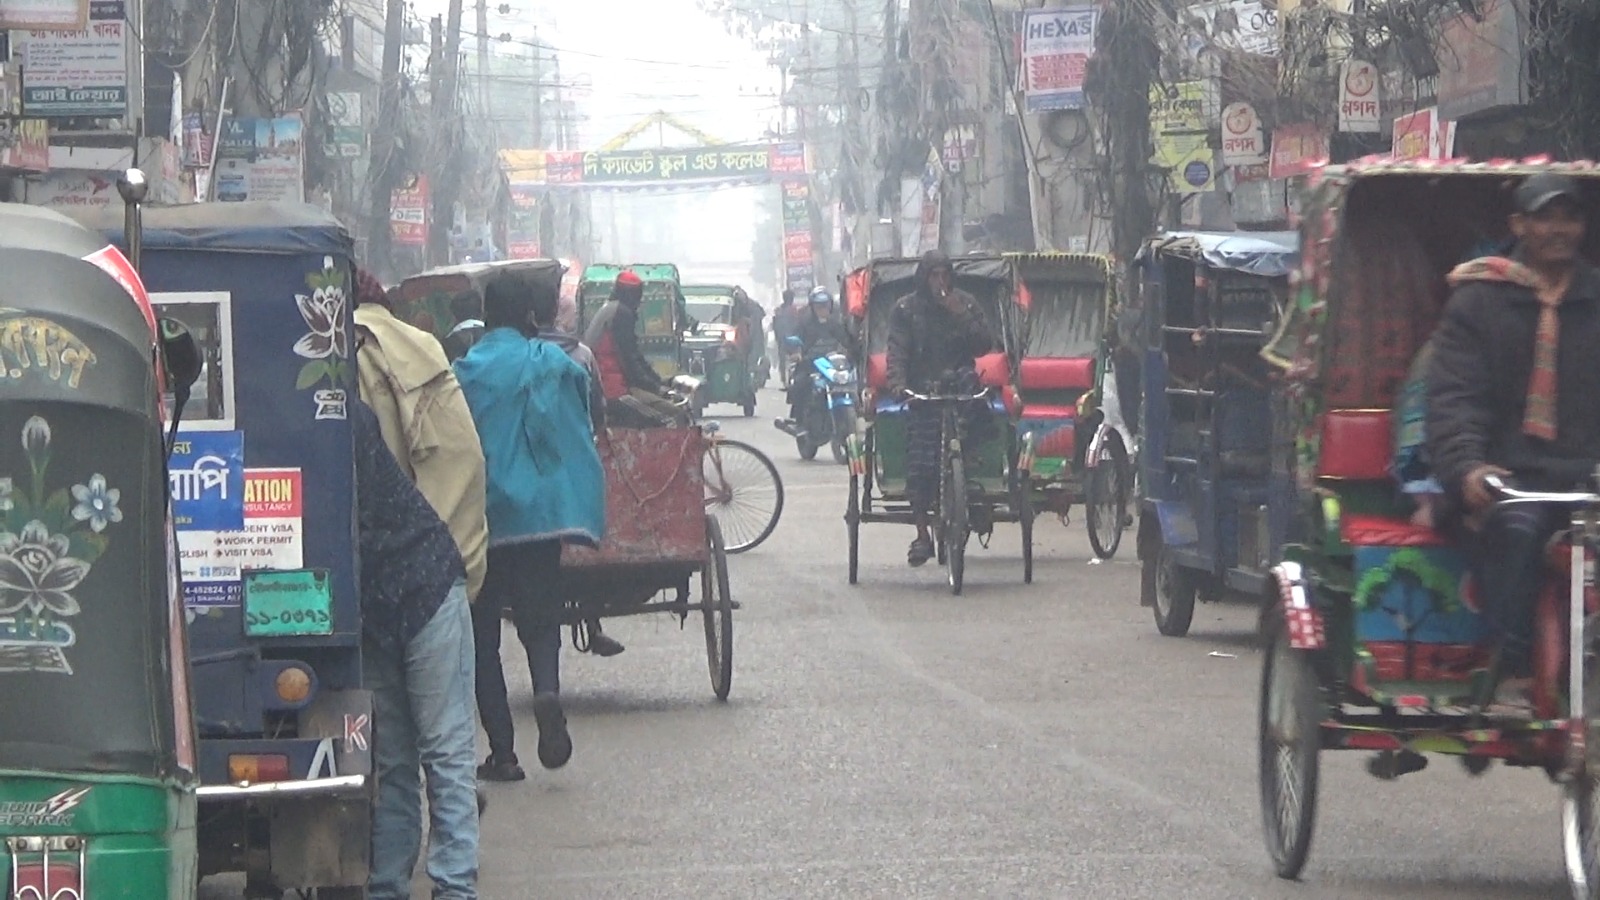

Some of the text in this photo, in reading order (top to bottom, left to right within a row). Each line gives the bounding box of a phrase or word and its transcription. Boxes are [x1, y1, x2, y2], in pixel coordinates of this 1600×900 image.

[1342, 101, 1377, 117] নগদ
[583, 152, 597, 175] দি
[602, 151, 654, 174] ক্যাডেট
[659, 155, 687, 178] স্কুল
[721, 151, 768, 170] কলেজ
[244, 479, 292, 502] ATION
[271, 524, 294, 533] VISA
[224, 536, 293, 545] WORK PERMIT
[224, 548, 274, 557] VISIT VISA
